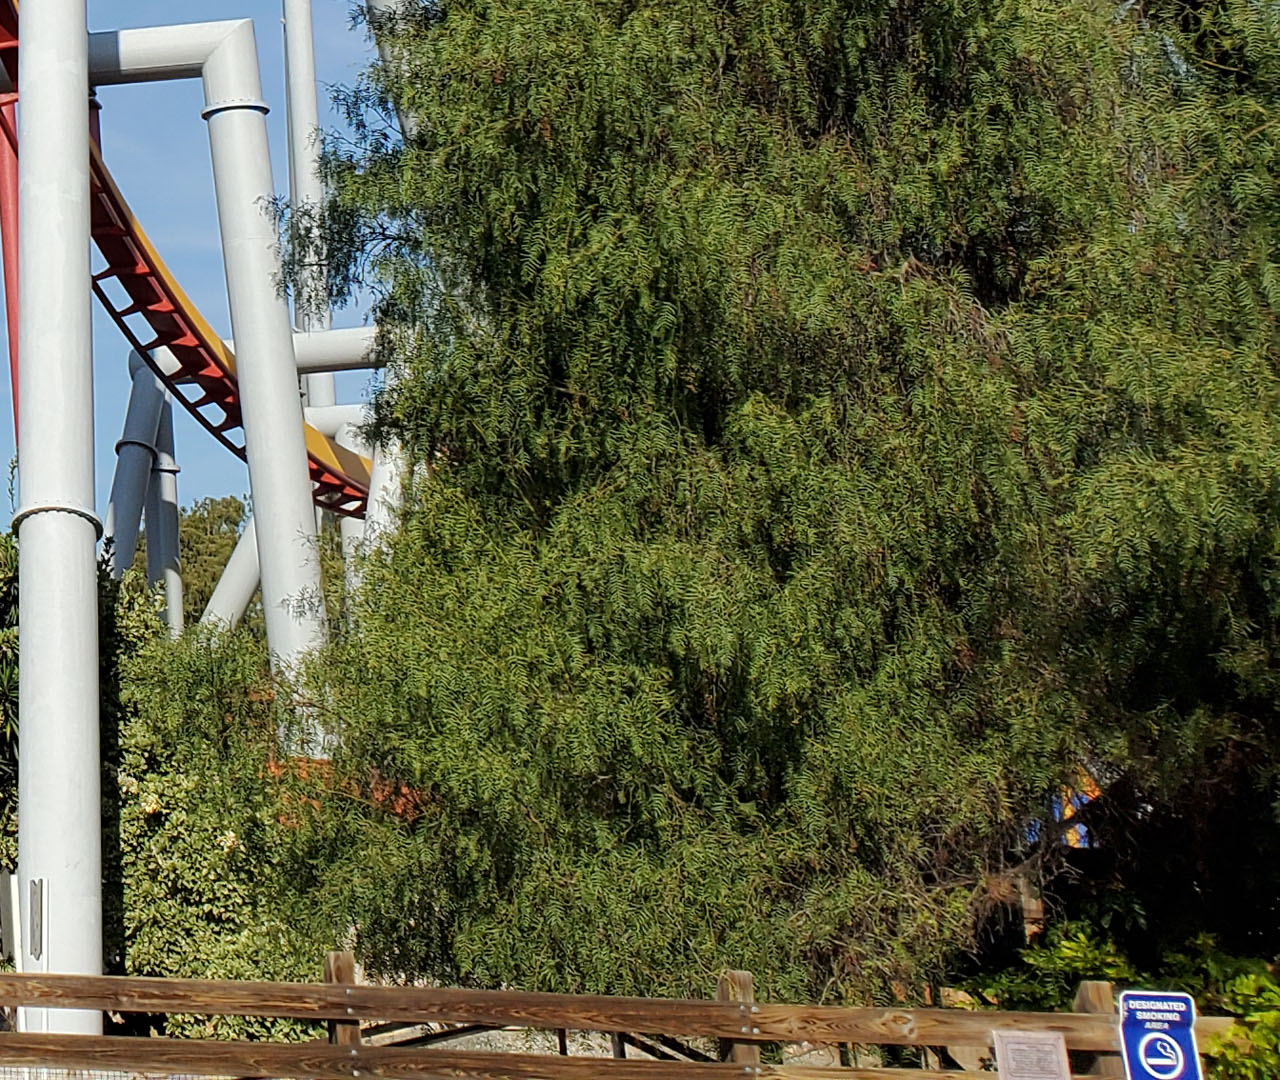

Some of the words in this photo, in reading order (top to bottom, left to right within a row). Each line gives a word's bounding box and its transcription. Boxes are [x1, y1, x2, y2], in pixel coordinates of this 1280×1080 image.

[1129, 1000, 1187, 1012] DESIGNATED
[1136, 1011, 1181, 1021] SMOKING
[1144, 1021, 1170, 1030] AREA
